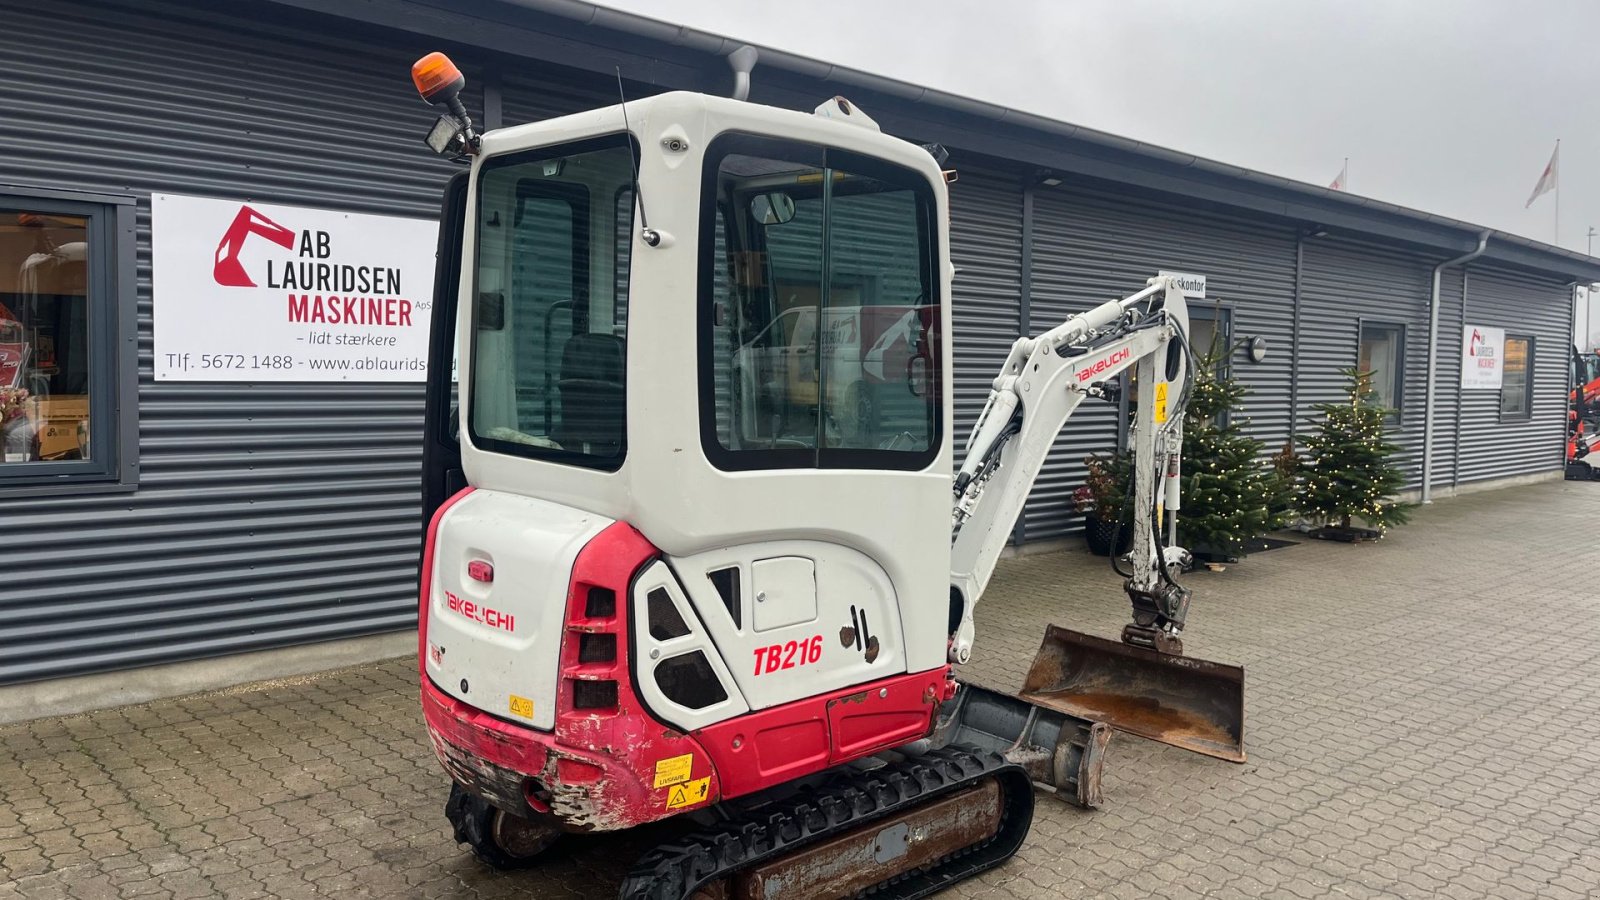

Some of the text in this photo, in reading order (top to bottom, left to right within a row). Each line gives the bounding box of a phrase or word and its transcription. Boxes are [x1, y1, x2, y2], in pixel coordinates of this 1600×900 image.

[299, 229, 331, 259] AB
[267, 259, 401, 295] LAURIDSEN
[288, 294, 432, 327] MASKINER ApS
[309, 332, 331, 345] lidt
[335, 332, 397, 347] stærkere
[165, 352, 195, 372] Tlf.
[201, 354, 245, 369] 5672
[251, 355, 293, 370] 1488
[754, 635, 823, 676] TB216
